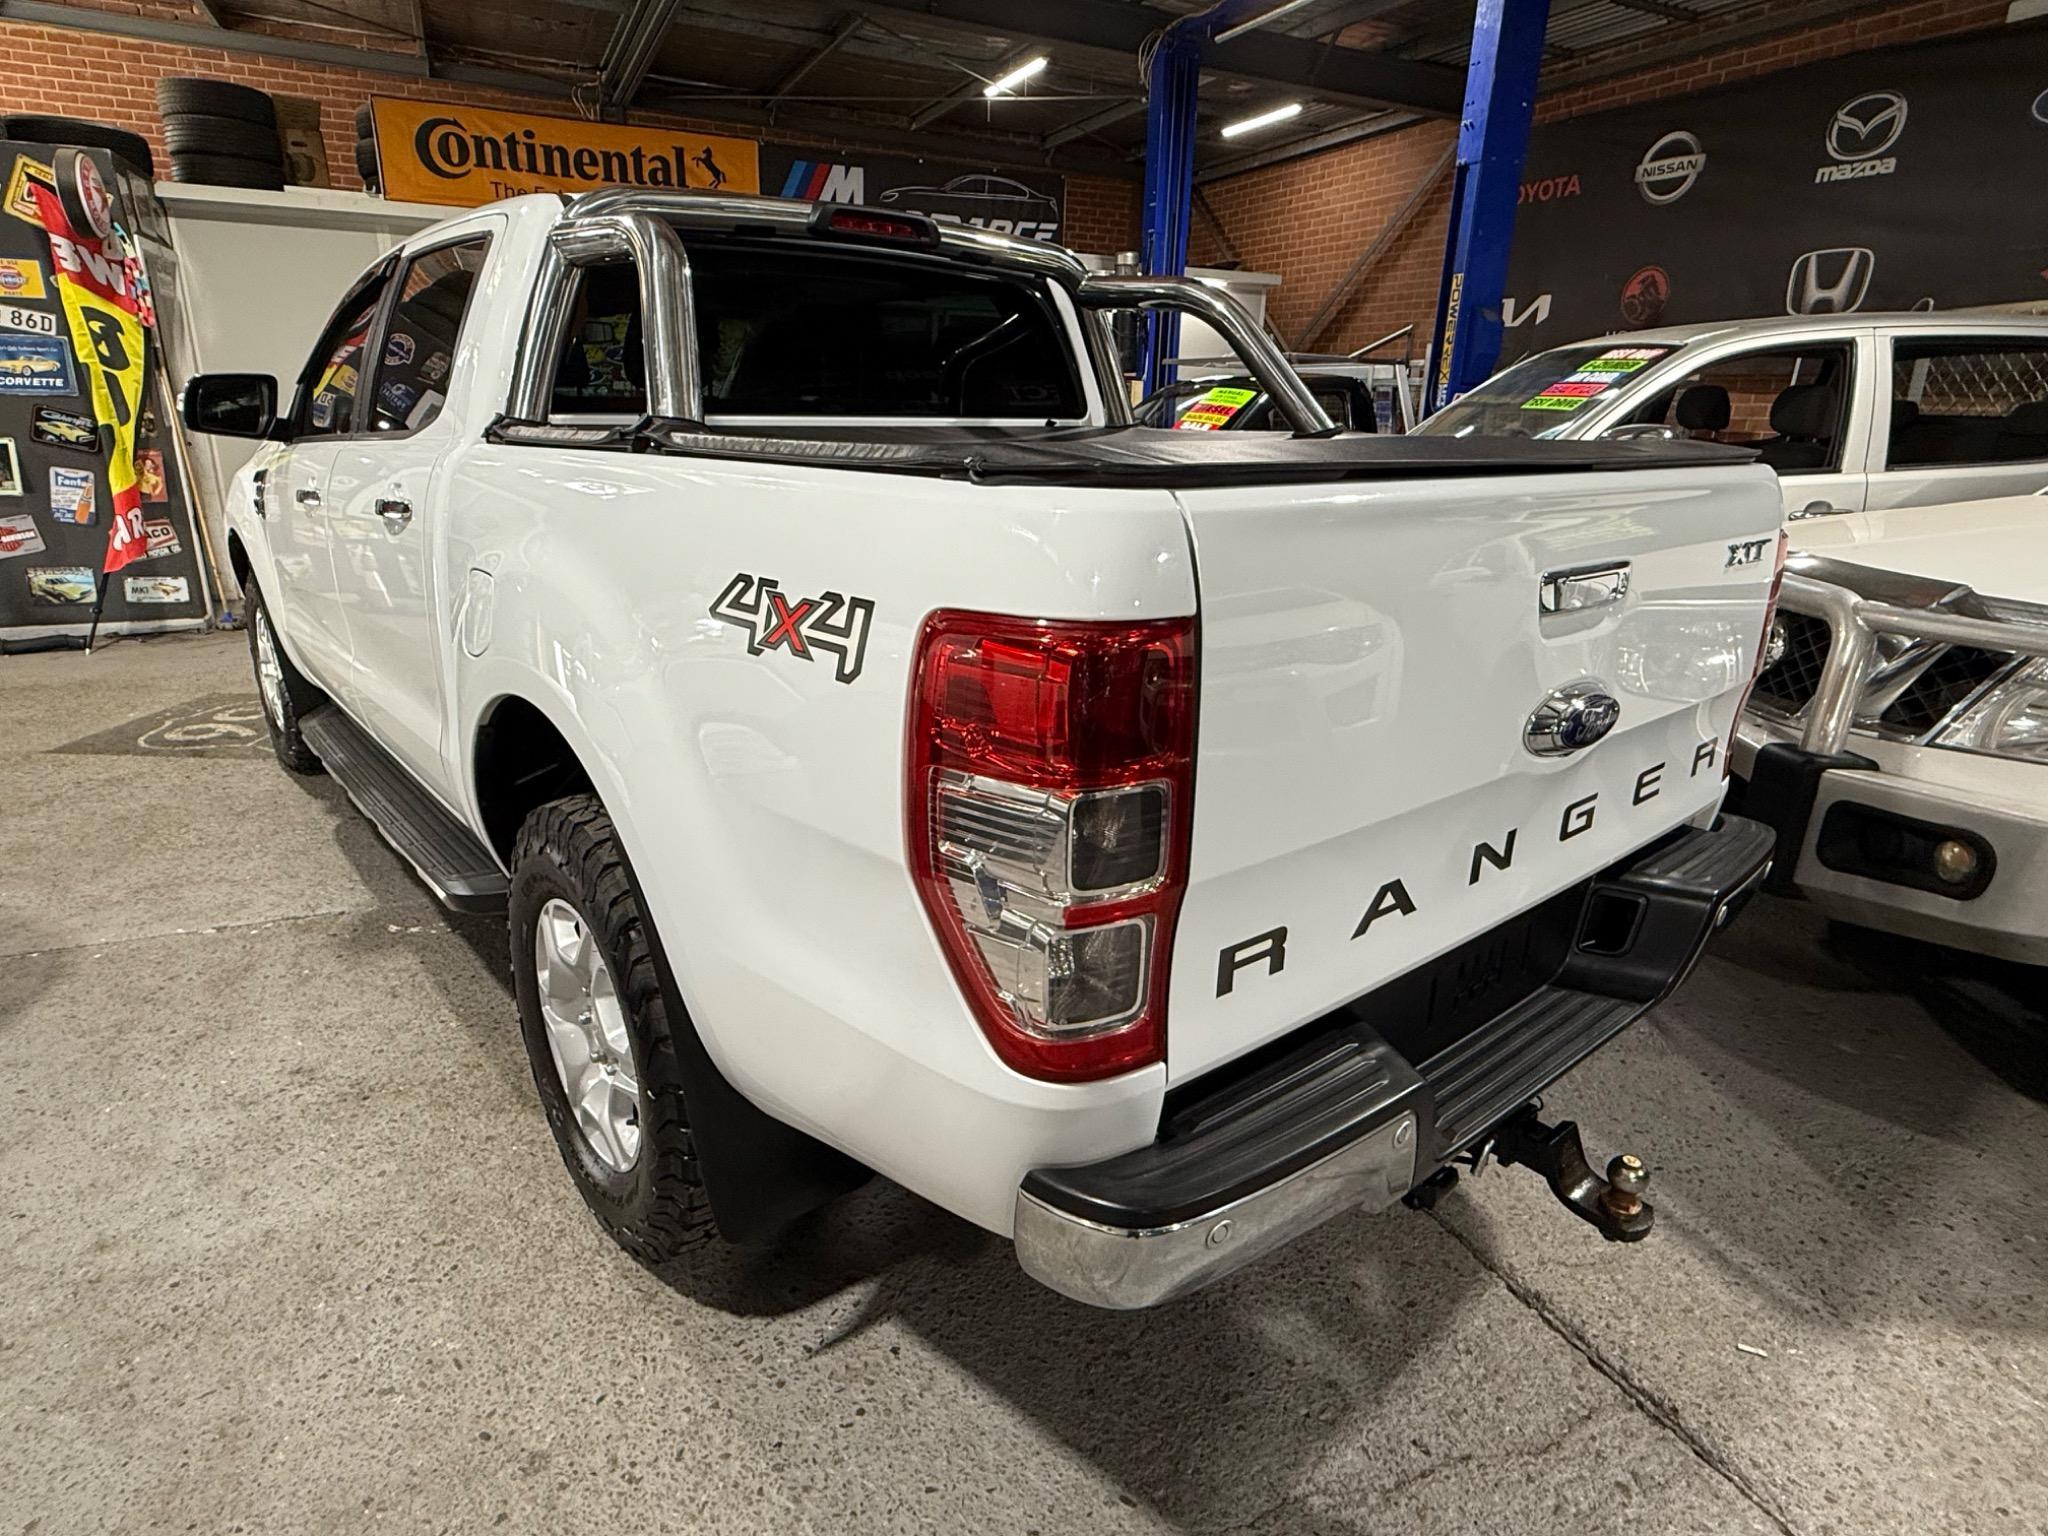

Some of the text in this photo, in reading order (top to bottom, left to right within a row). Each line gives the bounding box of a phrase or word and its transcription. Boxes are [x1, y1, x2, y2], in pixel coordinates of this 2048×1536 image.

[415, 117, 690, 188] Continental
[1642, 157, 1698, 178] NISSAN
[0, 376, 64, 387] CORVETTE
[1216, 737, 1719, 999] RANGER
